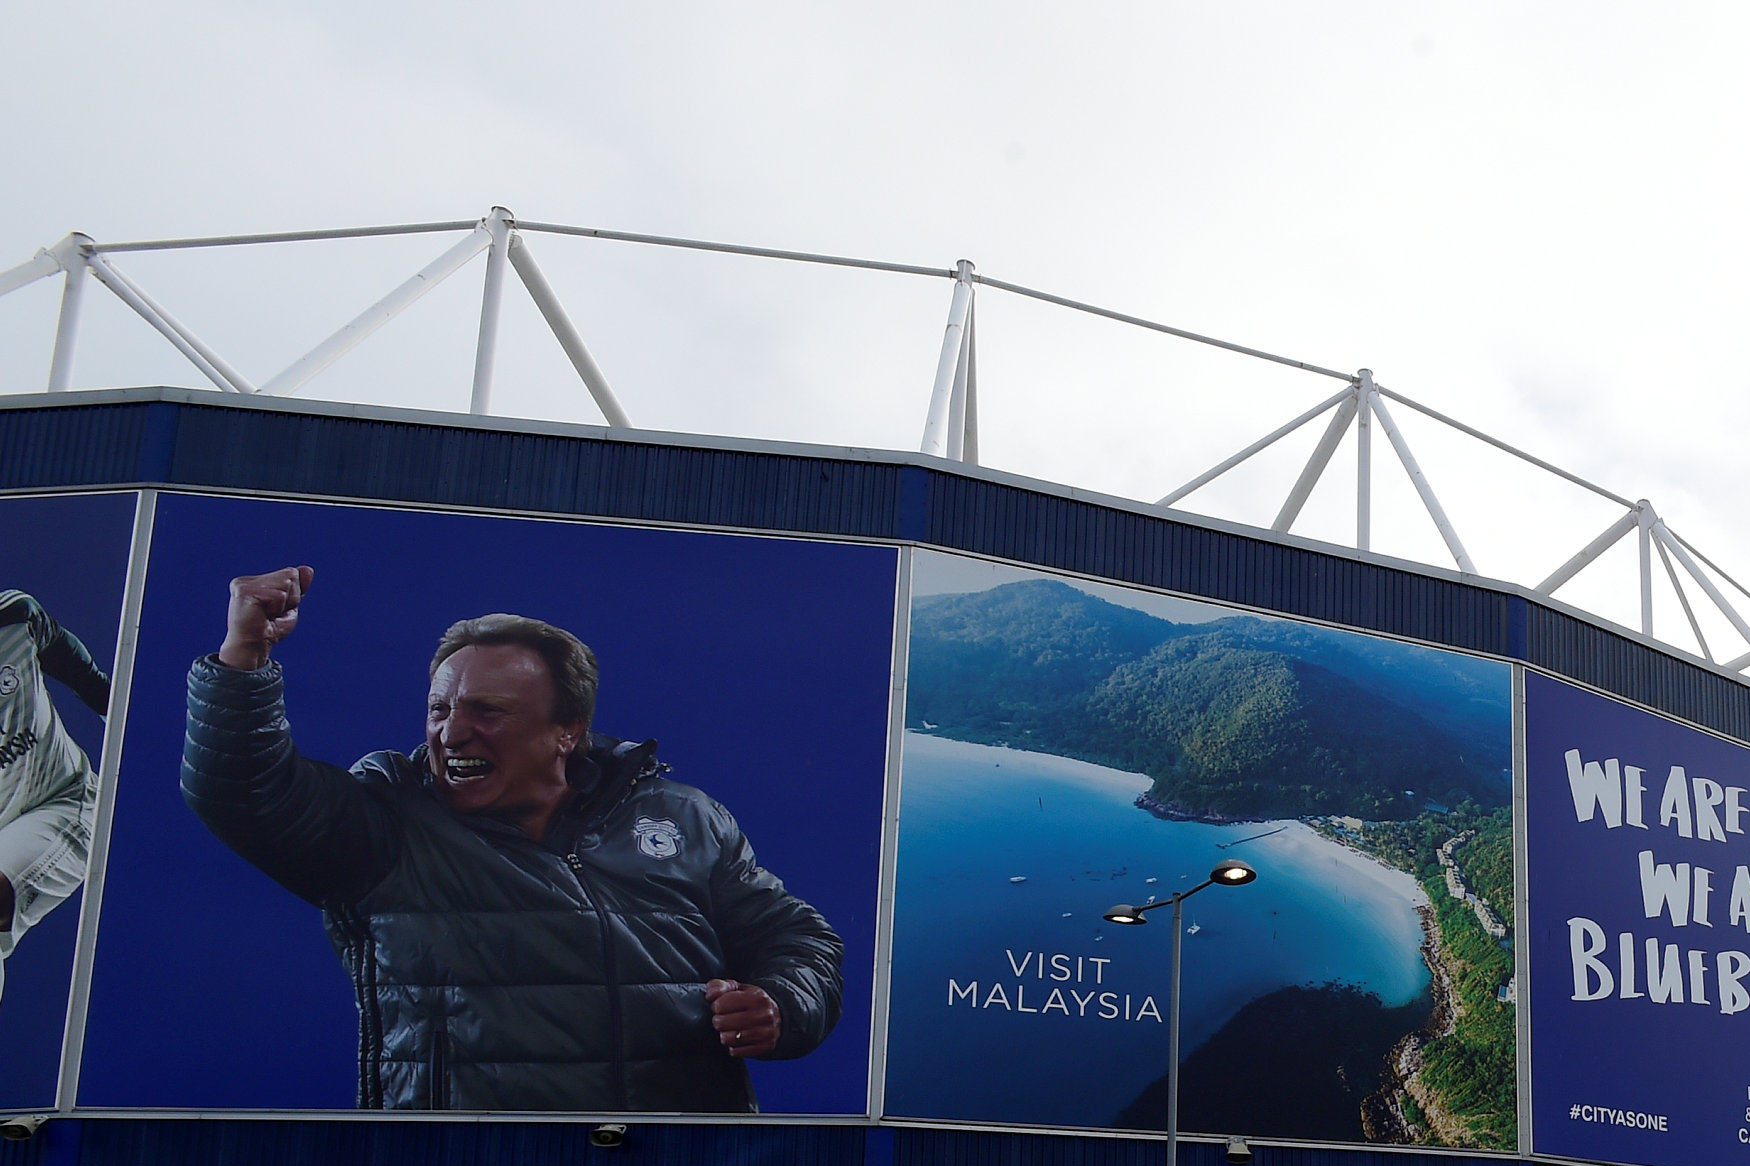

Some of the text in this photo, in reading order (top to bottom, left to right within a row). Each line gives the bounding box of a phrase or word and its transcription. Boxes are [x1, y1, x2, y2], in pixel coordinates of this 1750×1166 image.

[1564, 748, 1648, 830] WE
[1660, 765, 1750, 843] ARE
[1638, 851, 1713, 928] WE
[1006, 949, 1111, 984] VISIT
[948, 978, 1162, 1023] MALAYSIA
[1569, 1104, 1668, 1132] #CITYASONE
